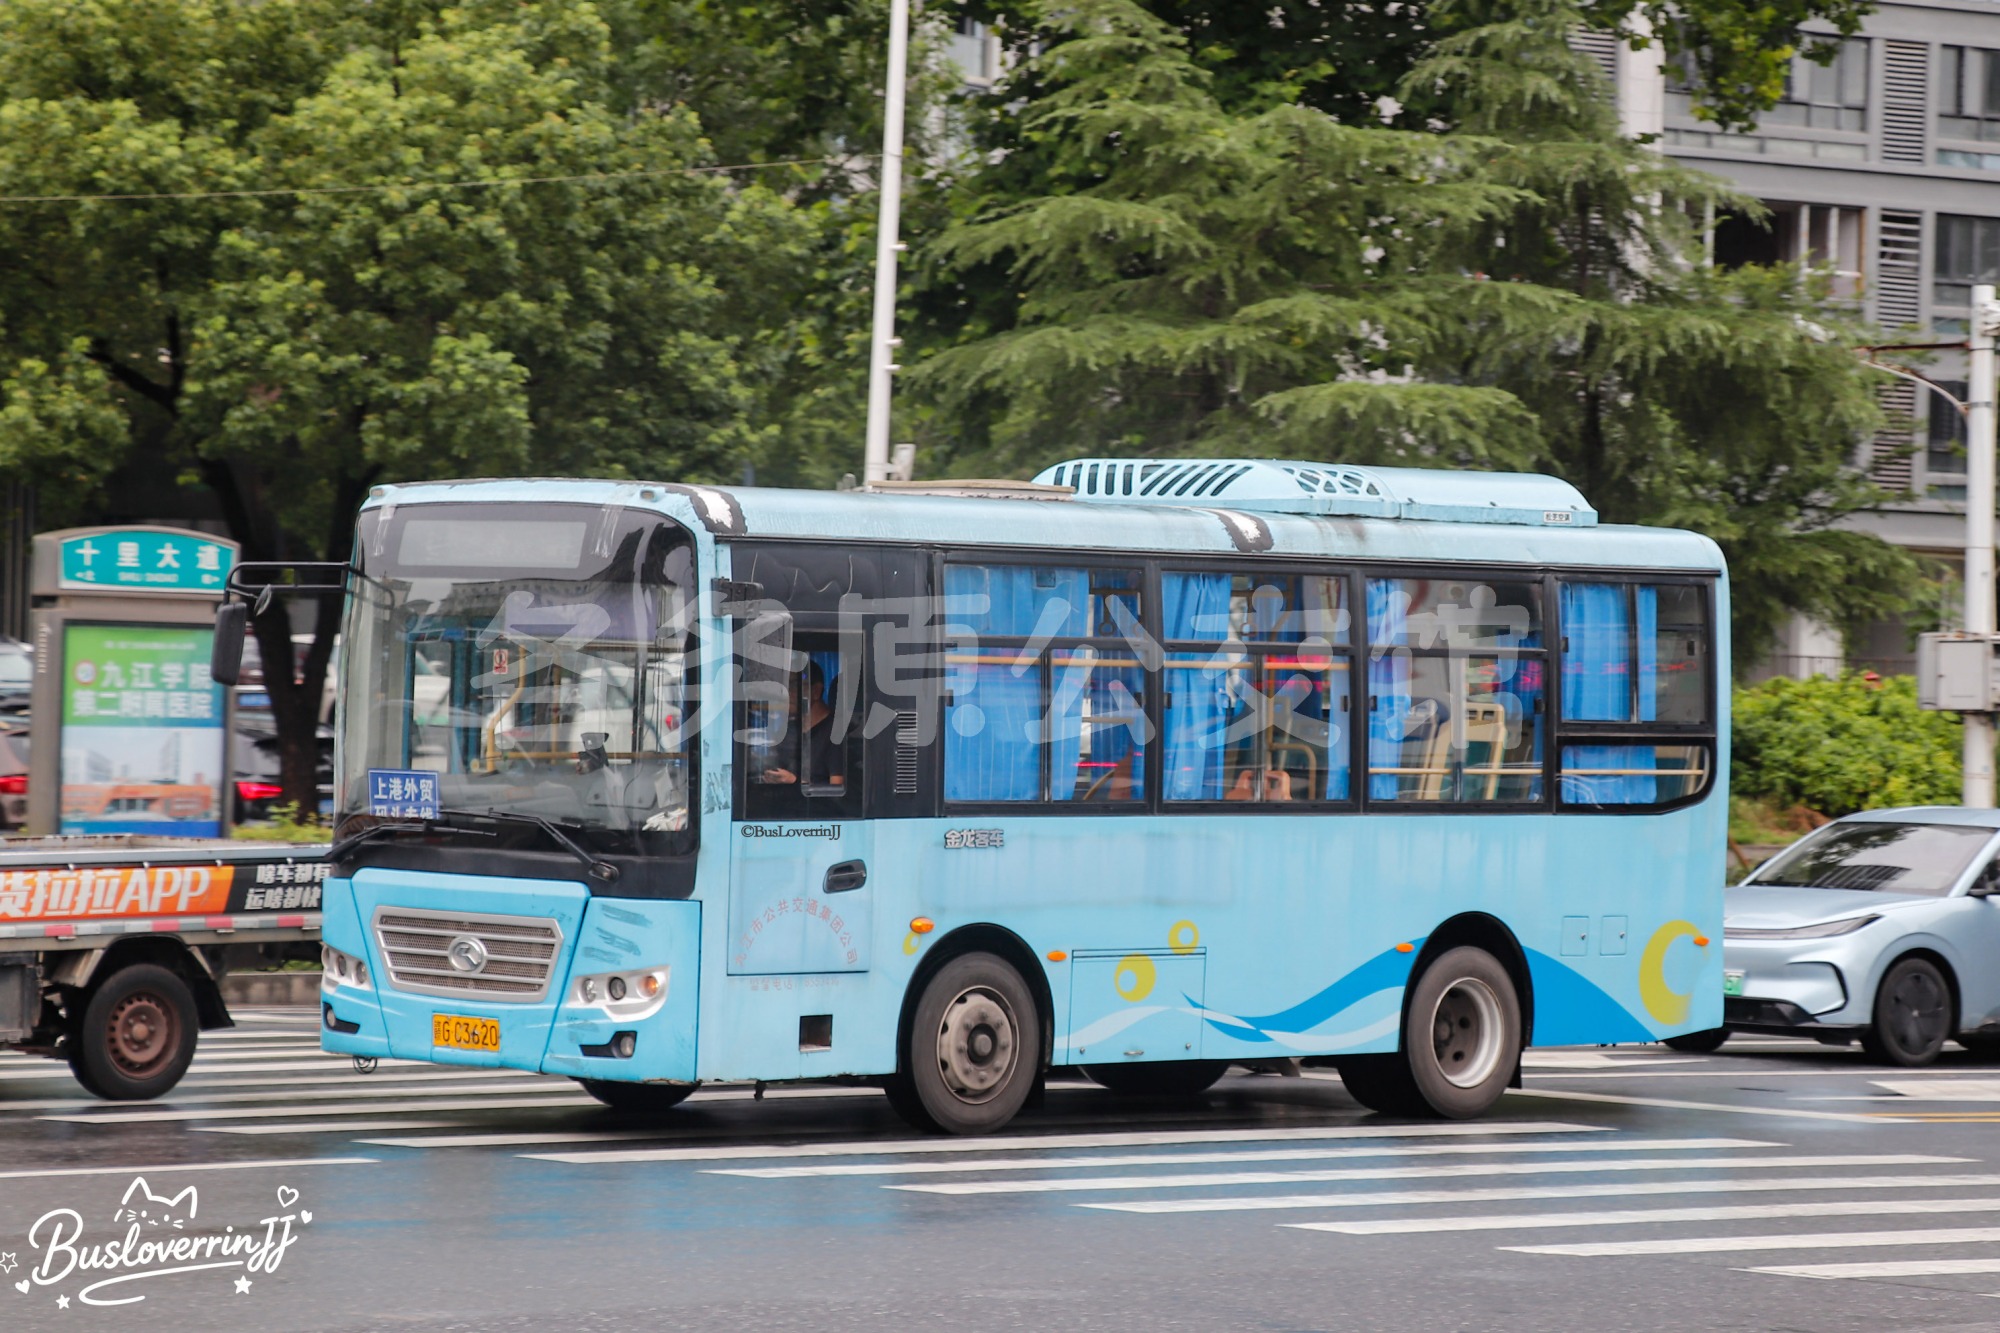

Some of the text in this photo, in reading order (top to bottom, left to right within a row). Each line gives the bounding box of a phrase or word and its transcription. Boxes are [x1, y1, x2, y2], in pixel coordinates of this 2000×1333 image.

[75, 540, 221, 570] 十里大道
[101, 661, 212, 689] 九江学院
[374, 777, 433, 802] 上港外贸
[944, 829, 1004, 849] 金龙客车
[256, 863, 332, 884] 啥车都有
[0, 868, 211, 917] 货拉拉APP
[244, 886, 322, 910] 运啥都快
